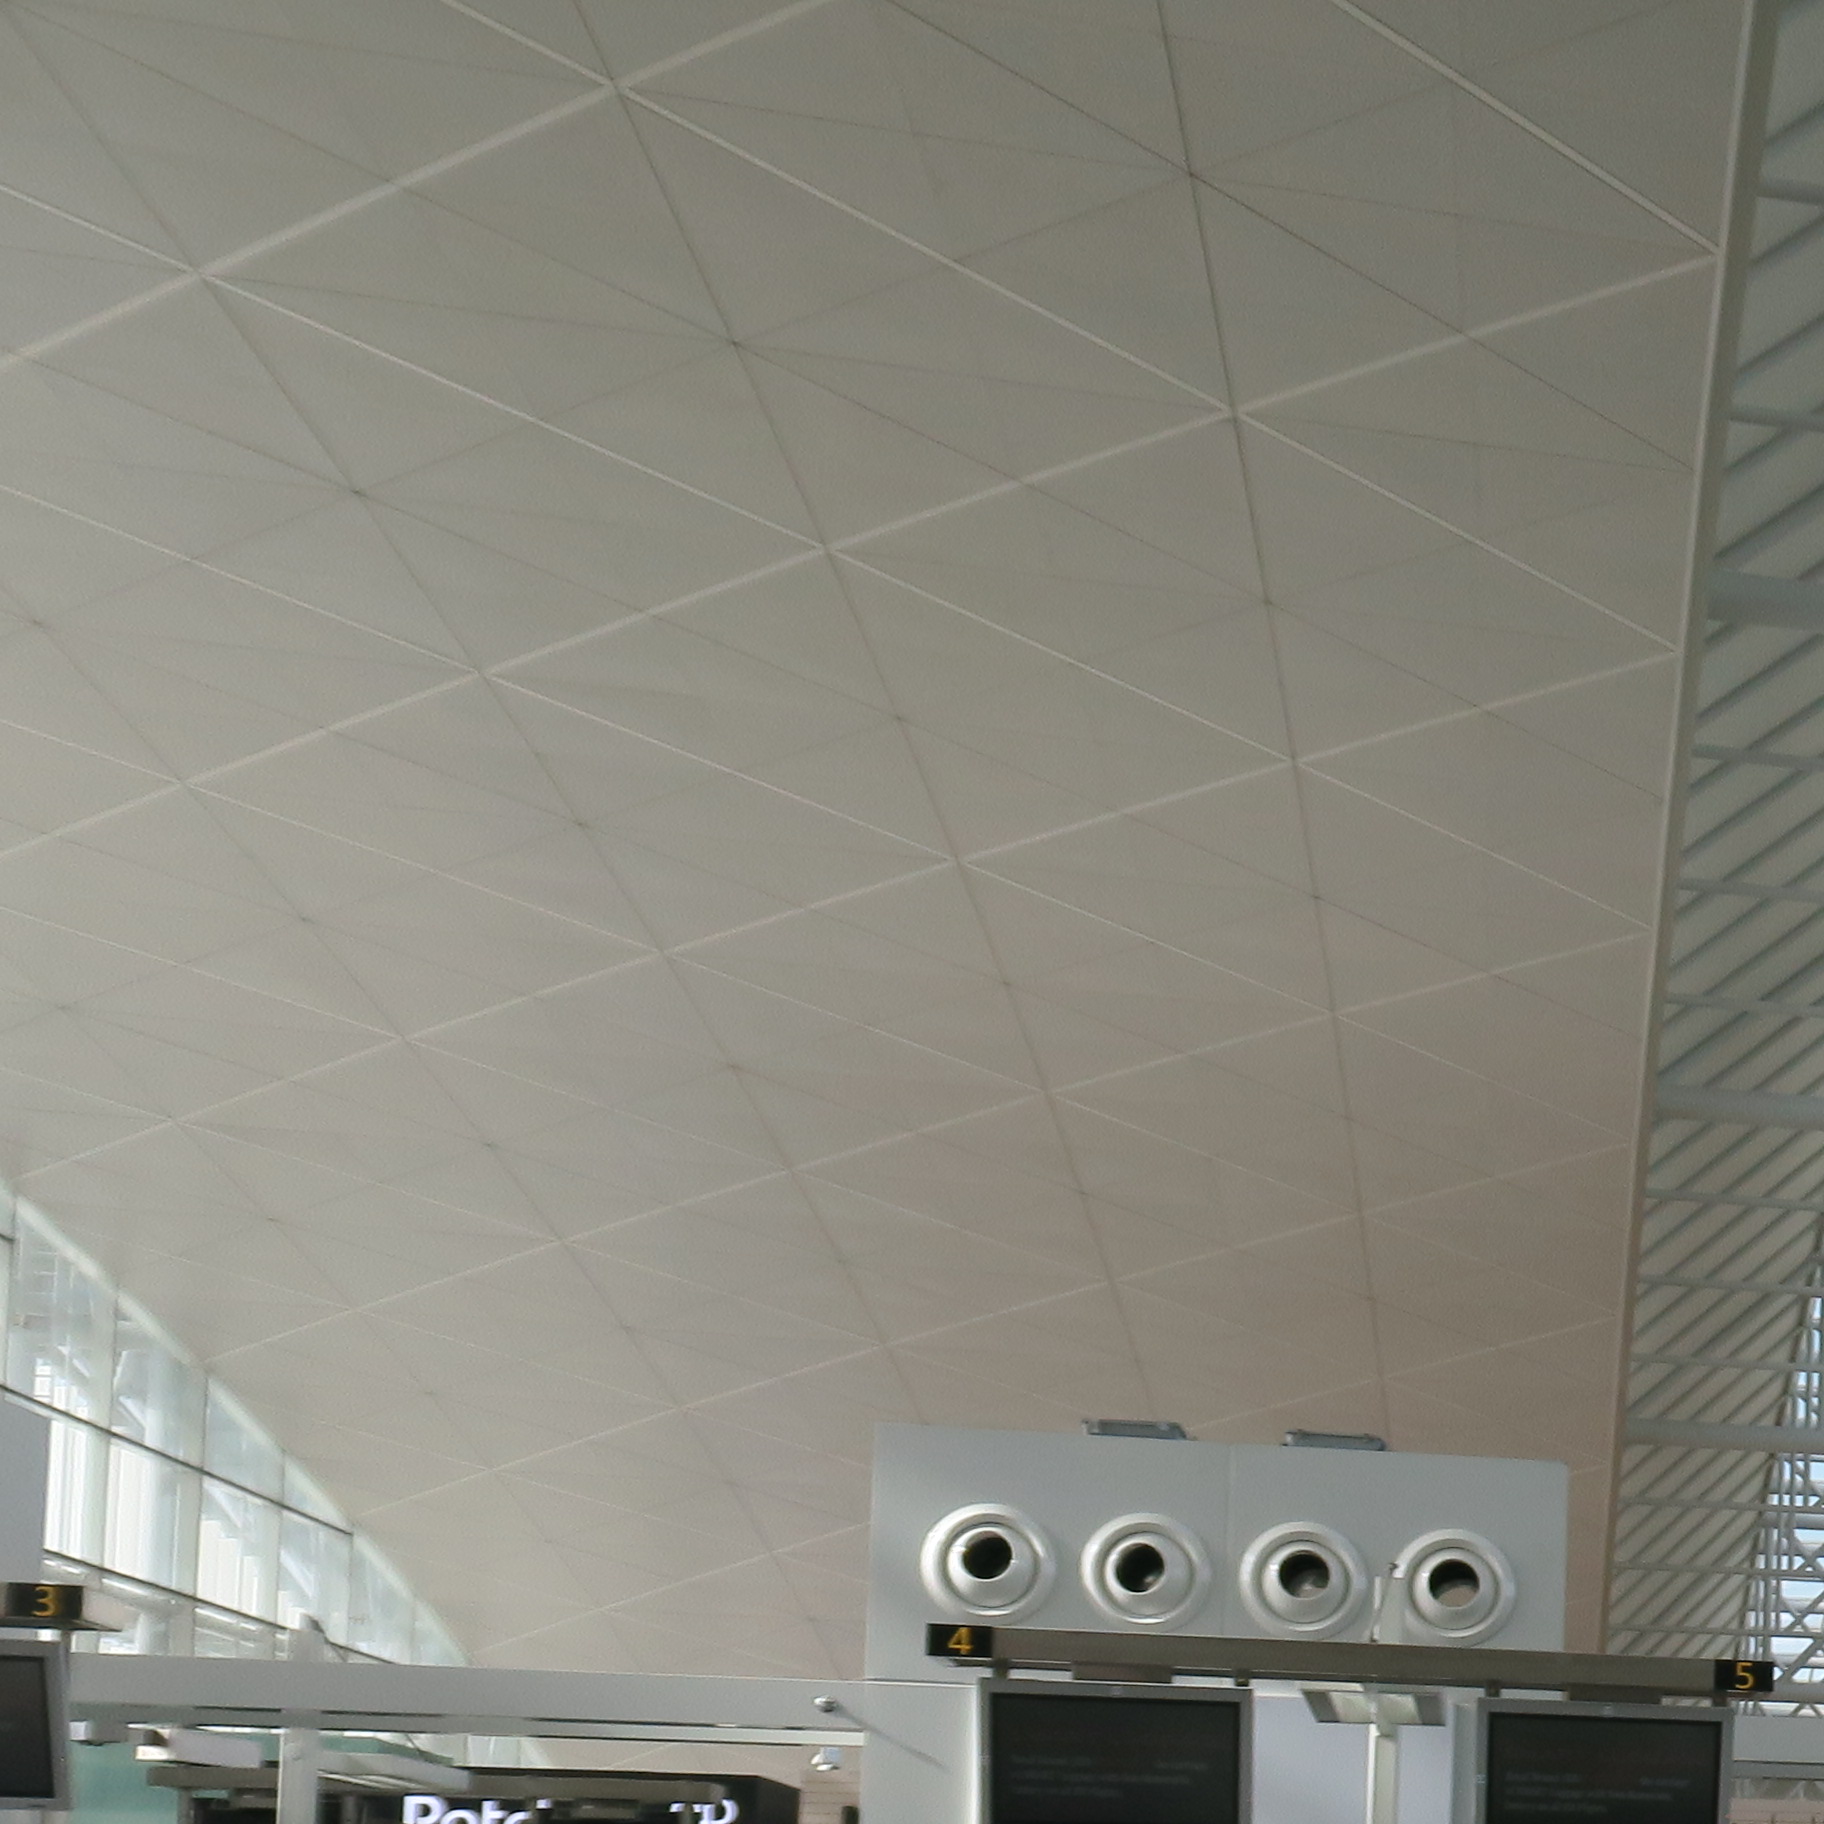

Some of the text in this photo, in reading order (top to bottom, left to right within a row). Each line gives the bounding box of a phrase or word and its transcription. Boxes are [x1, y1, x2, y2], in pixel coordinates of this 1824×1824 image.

[33, 1586, 61, 1617] 3
[948, 1626, 973, 1655] 4
[1735, 1662, 1755, 1690] 5
